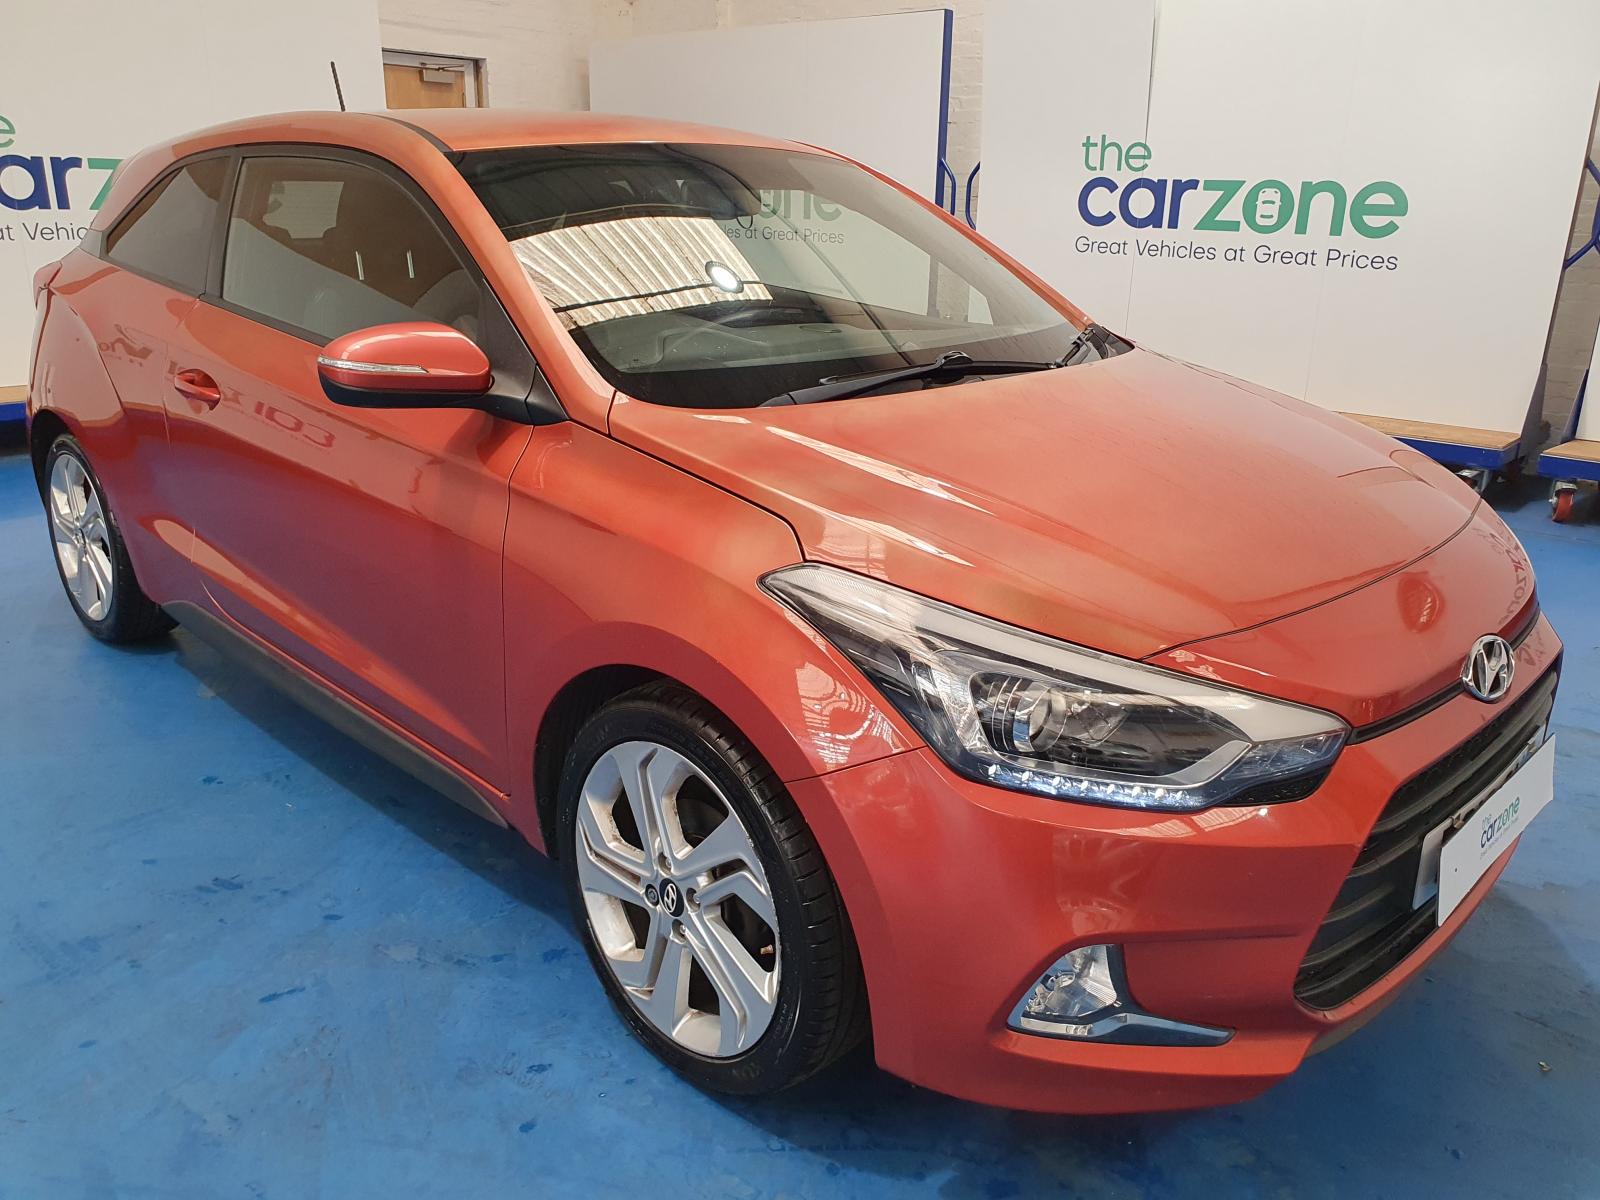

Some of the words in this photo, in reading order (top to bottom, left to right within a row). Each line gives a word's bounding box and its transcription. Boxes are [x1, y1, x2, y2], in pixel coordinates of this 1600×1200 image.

[1082, 134, 1152, 172] the
[1078, 176, 1409, 239] carzone
[745, 228, 758, 240] at
[762, 226, 799, 241] Great
[803, 228, 845, 244] Prices
[1075, 236, 1128, 255] Great
[1136, 239, 1217, 261] Vehicles
[1224, 246, 1246, 262] at
[1254, 244, 1317, 266] Great
[1326, 248, 1399, 270] Prices
[1480, 796, 1520, 848] carzone
